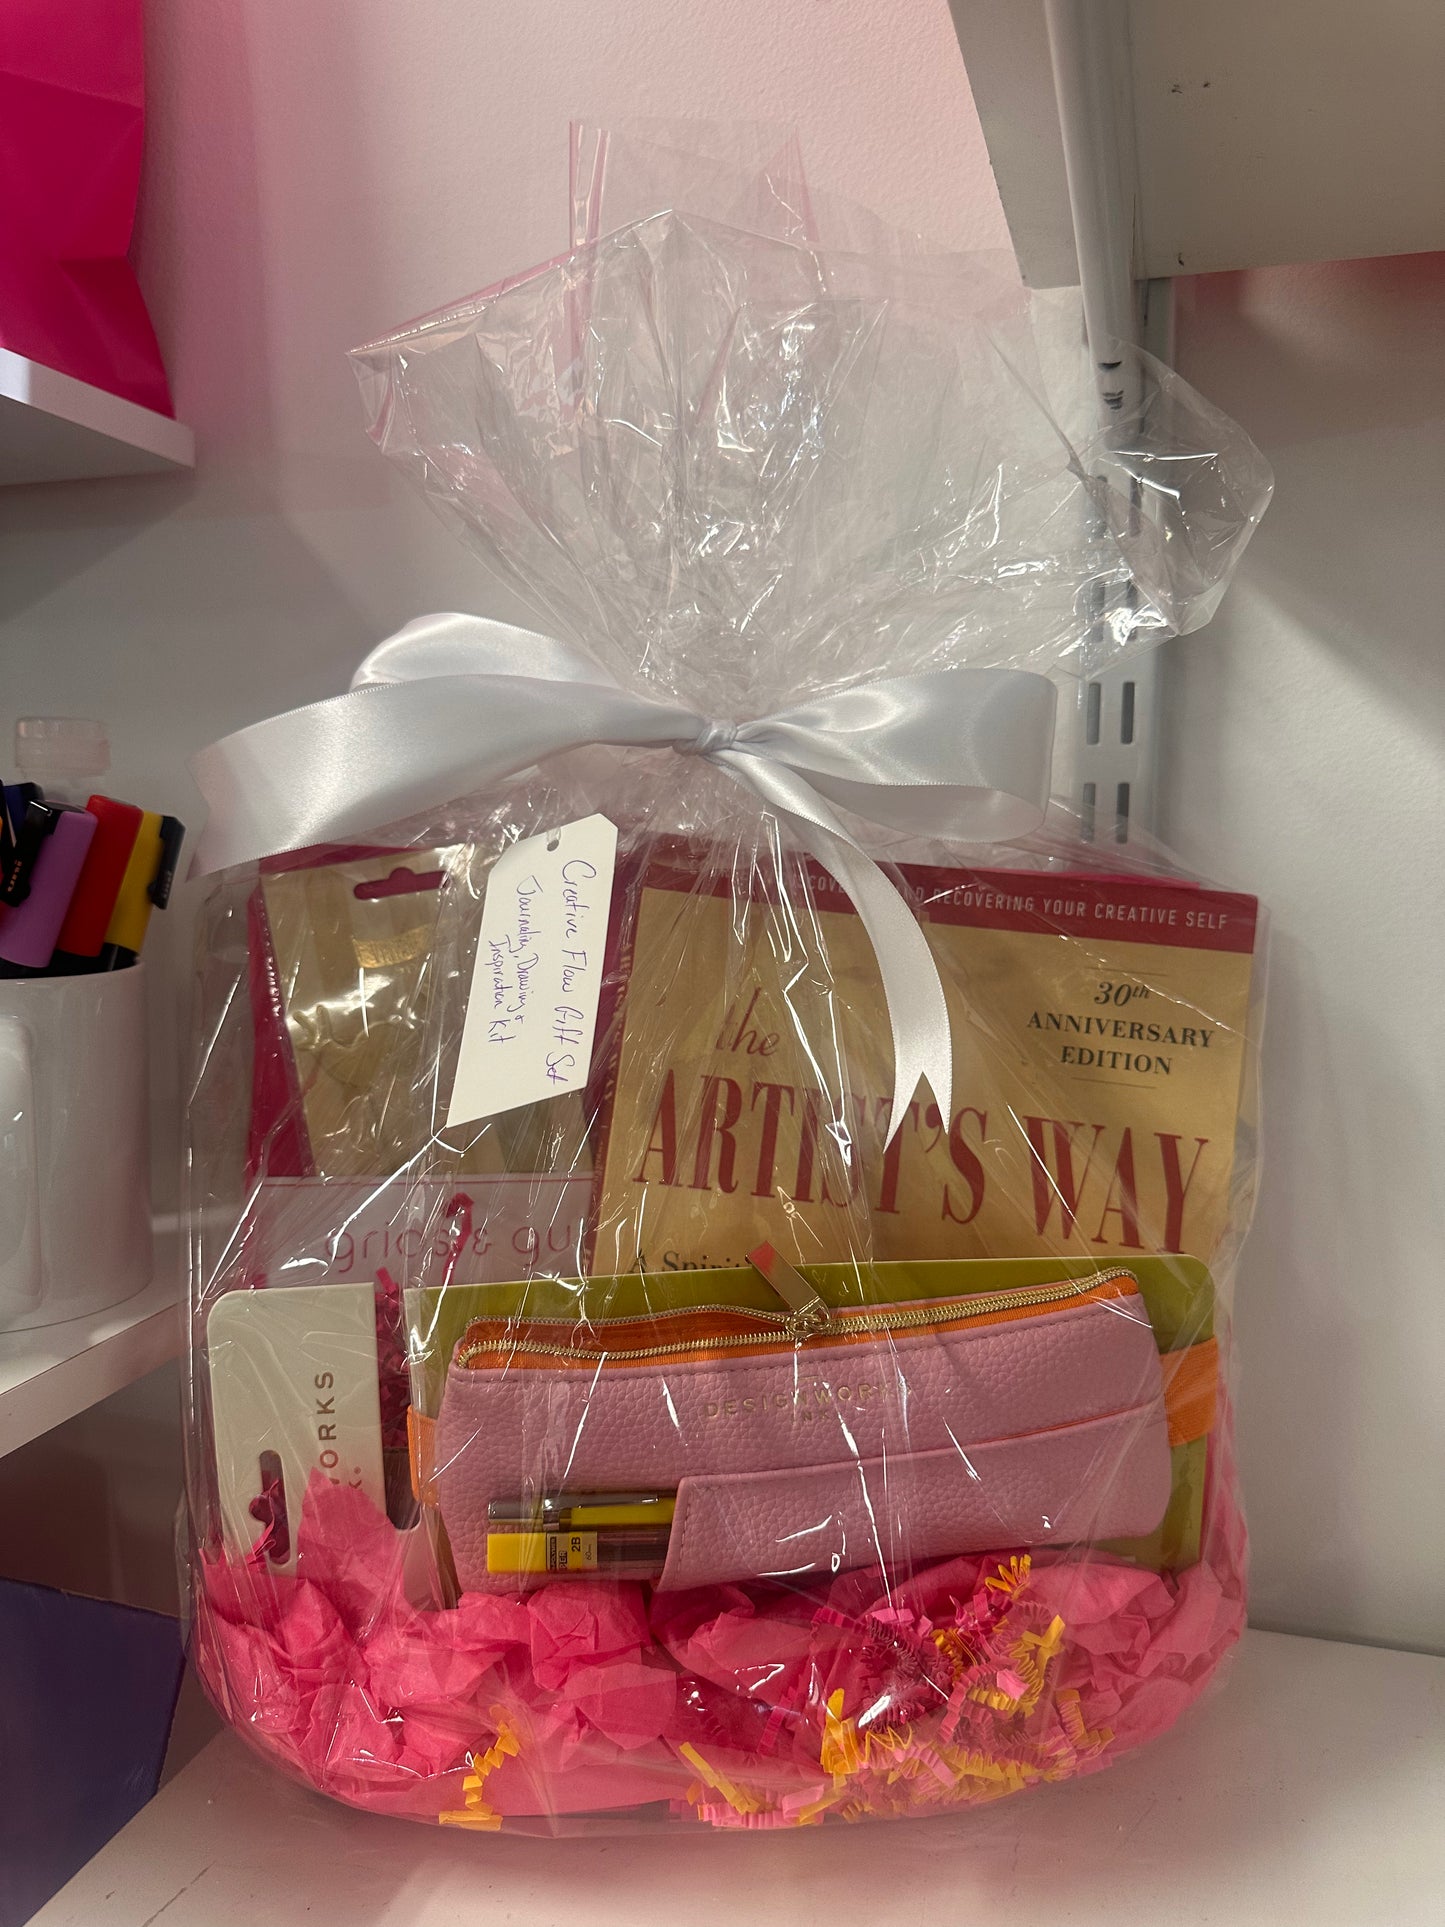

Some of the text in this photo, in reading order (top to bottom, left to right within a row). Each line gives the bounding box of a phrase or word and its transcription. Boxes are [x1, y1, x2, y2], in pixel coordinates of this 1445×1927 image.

[933, 888, 1034, 912] RECOVERING
[1043, 898, 1086, 917] YOUR
[1094, 902, 1177, 925] CREATIVE
[1185, 911, 1228, 931] SELF
[507, 953, 539, 1012] Drawing
[546, 860, 597, 1085] Creative Flow Gift Set
[1094, 981, 1150, 1007] 30th
[488, 1019, 517, 1043] Kit
[716, 987, 780, 1056] the
[1027, 1011, 1215, 1048] ANNIVERSARY
[1060, 1046, 1173, 1075] EDITION
[633, 1069, 1209, 1255] ARTIST'S WAY
[472, 1227, 493, 1255] &
[315, 1371, 340, 1485] ORKS
[571, 1537, 581, 1552] 2B
